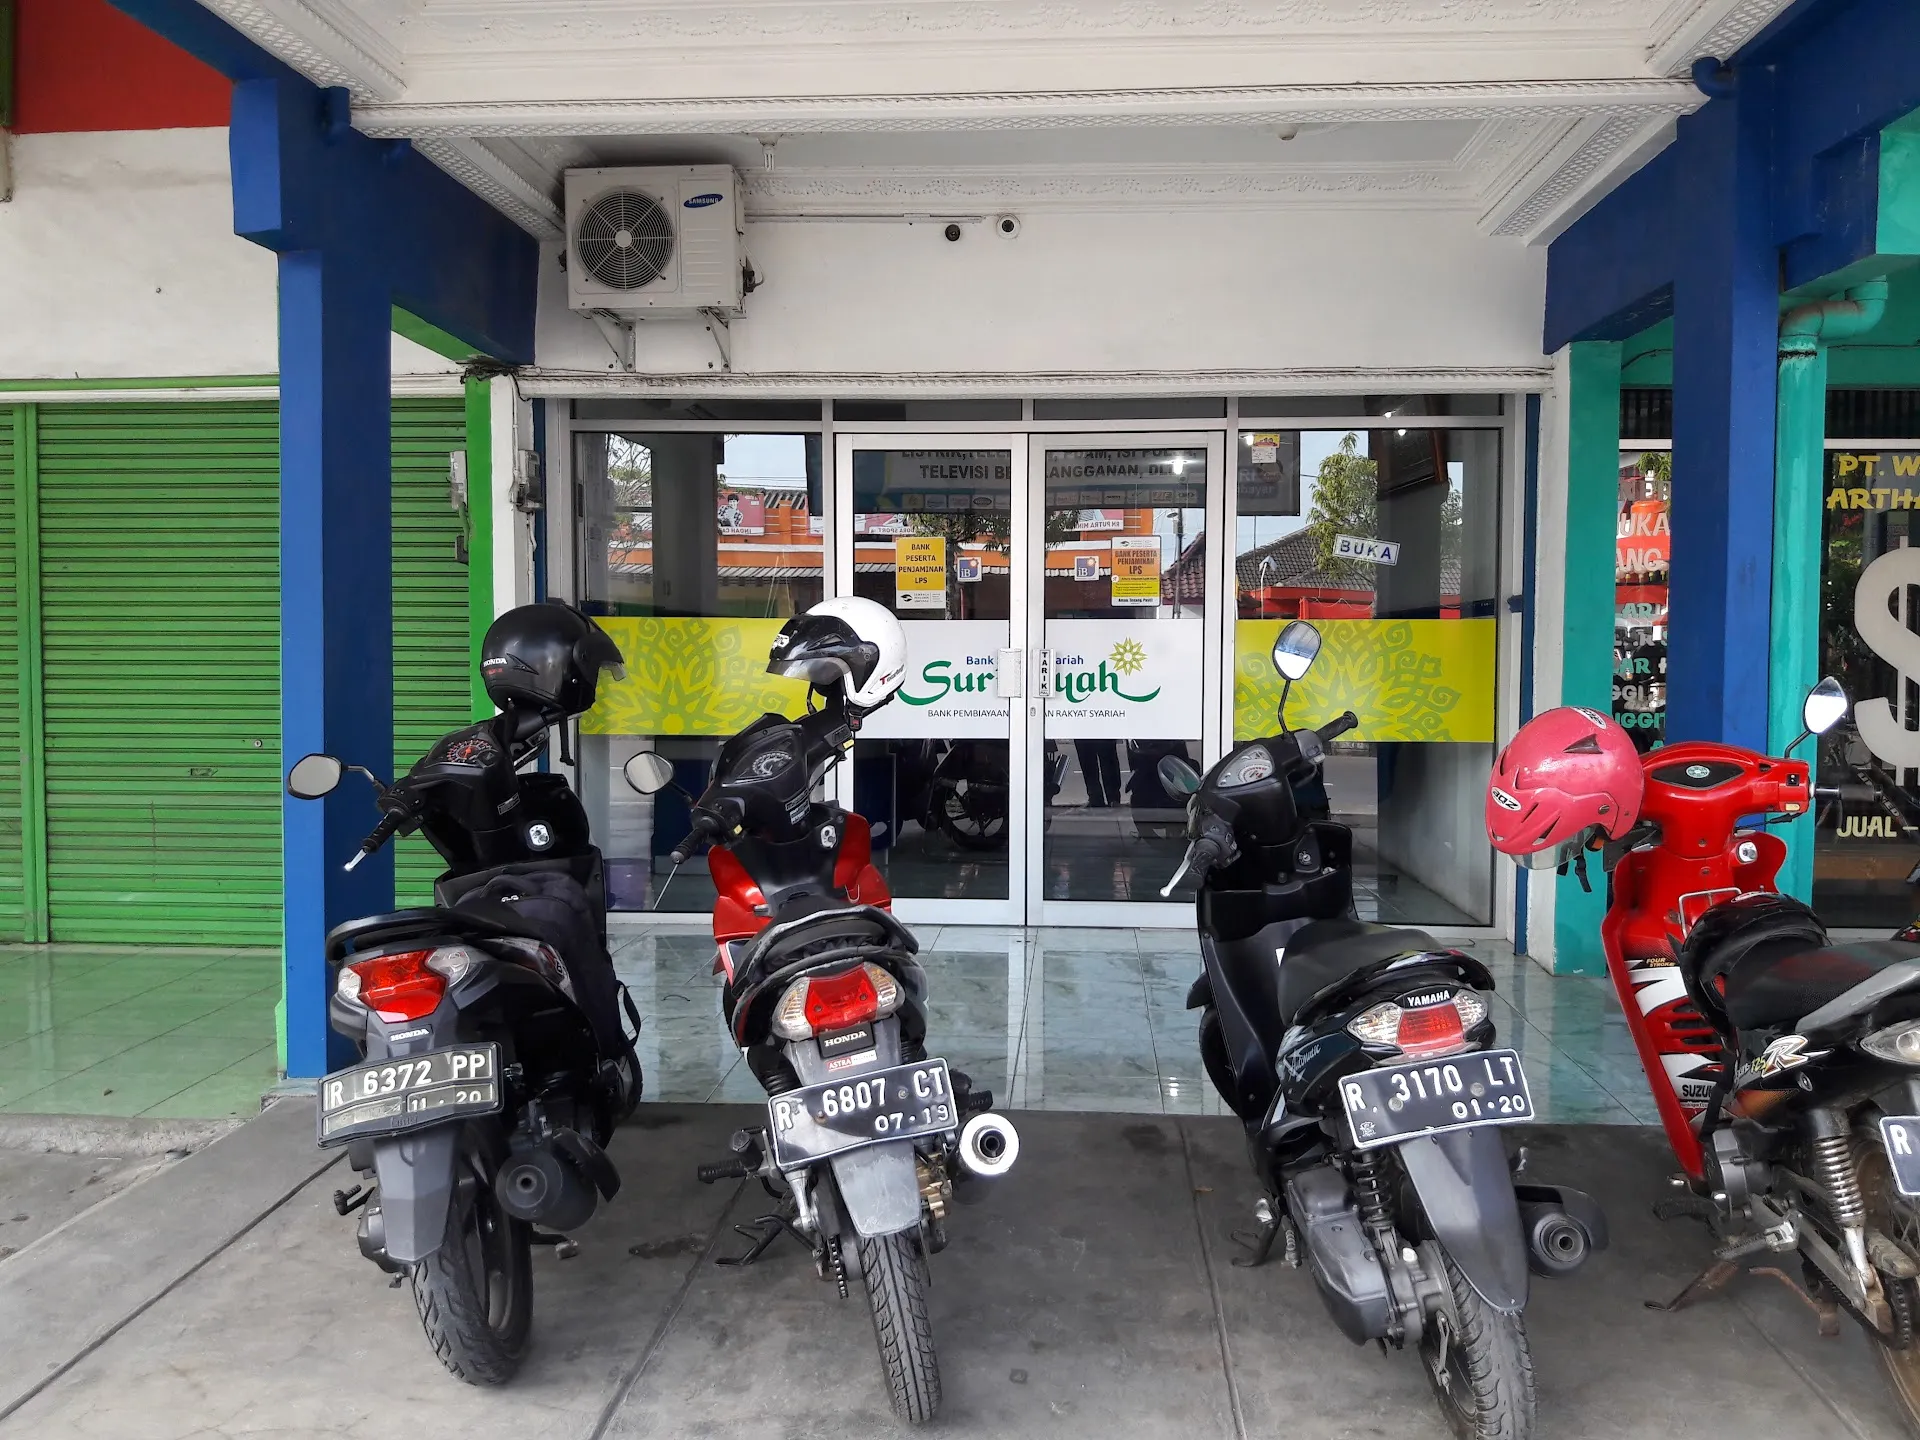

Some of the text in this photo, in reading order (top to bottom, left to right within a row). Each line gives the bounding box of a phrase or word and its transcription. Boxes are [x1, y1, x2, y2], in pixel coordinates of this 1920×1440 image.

[689, 197, 719, 205] SAMSUNG
[919, 464, 989, 479] TELEVISI
[1838, 455, 1885, 476] PT.
[1340, 539, 1391, 560] BUKA
[961, 568, 971, 578] iB
[1078, 567, 1088, 577] iB
[1129, 565, 1143, 575] LPS
[966, 654, 1084, 666] Bank ariah
[928, 709, 951, 718] BANK
[1056, 709, 1087, 718] RAKYAT
[1089, 709, 1126, 718] SYARIAH
[1836, 815, 1897, 838] JUAL
[1407, 990, 1450, 1007] YAMAHA
[390, 1028, 430, 1042] HONDA
[824, 1030, 868, 1047] HONDA
[829, 1058, 852, 1070] ASTRA
[330, 1053, 486, 1109] R 6372 PP
[1391, 1064, 1463, 1101] 3170
[1483, 1056, 1517, 1087] LT
[1682, 1084, 1711, 1097] SUZU
[775, 1066, 947, 1132] R 6807 CT
[1889, 1124, 1912, 1155] R
